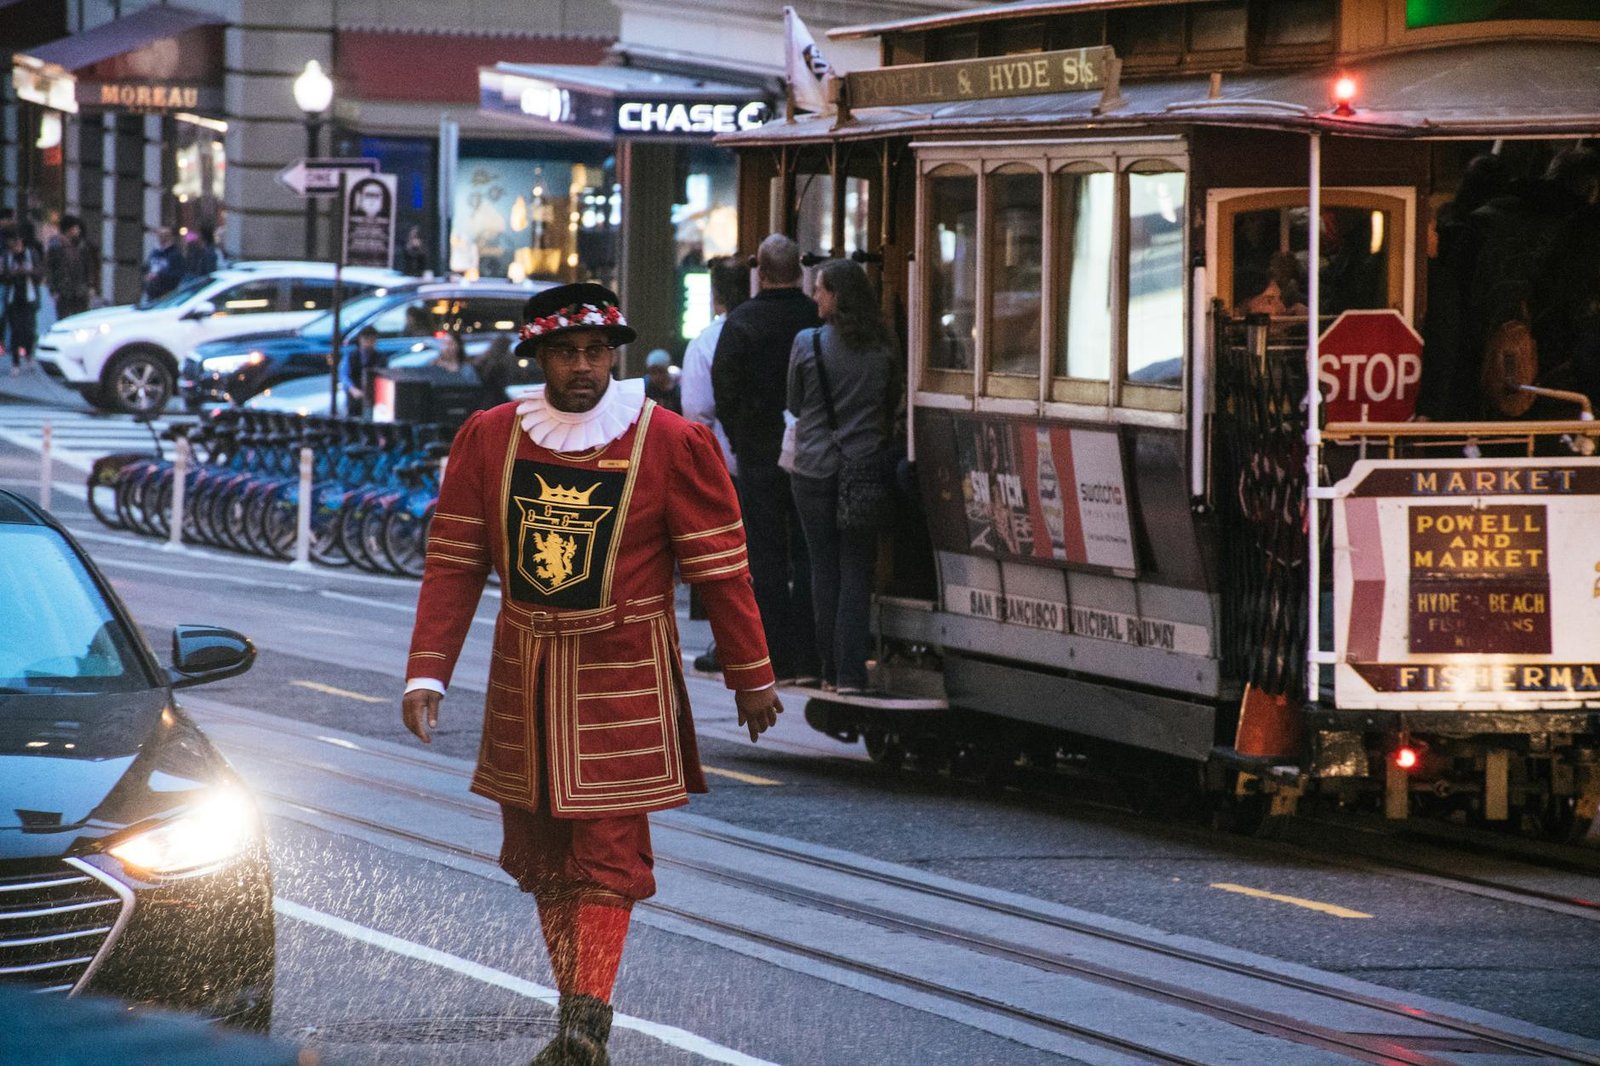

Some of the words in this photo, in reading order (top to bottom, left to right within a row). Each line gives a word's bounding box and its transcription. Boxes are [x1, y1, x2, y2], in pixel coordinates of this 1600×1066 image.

[957, 69, 972, 95] &
[989, 60, 1050, 92] HYDE
[101, 84, 199, 108] MOREAU
[618, 102, 738, 133] CHASE
[1318, 353, 1422, 402] STOP
[1414, 470, 1576, 493] MARKET
[1416, 514, 1541, 533] POWELL
[1450, 534, 1511, 548] AND
[1414, 549, 1543, 568] MARKET
[970, 590, 993, 617] SAN
[1417, 592, 1461, 613] HYDE
[1488, 593, 1545, 613] BEACH
